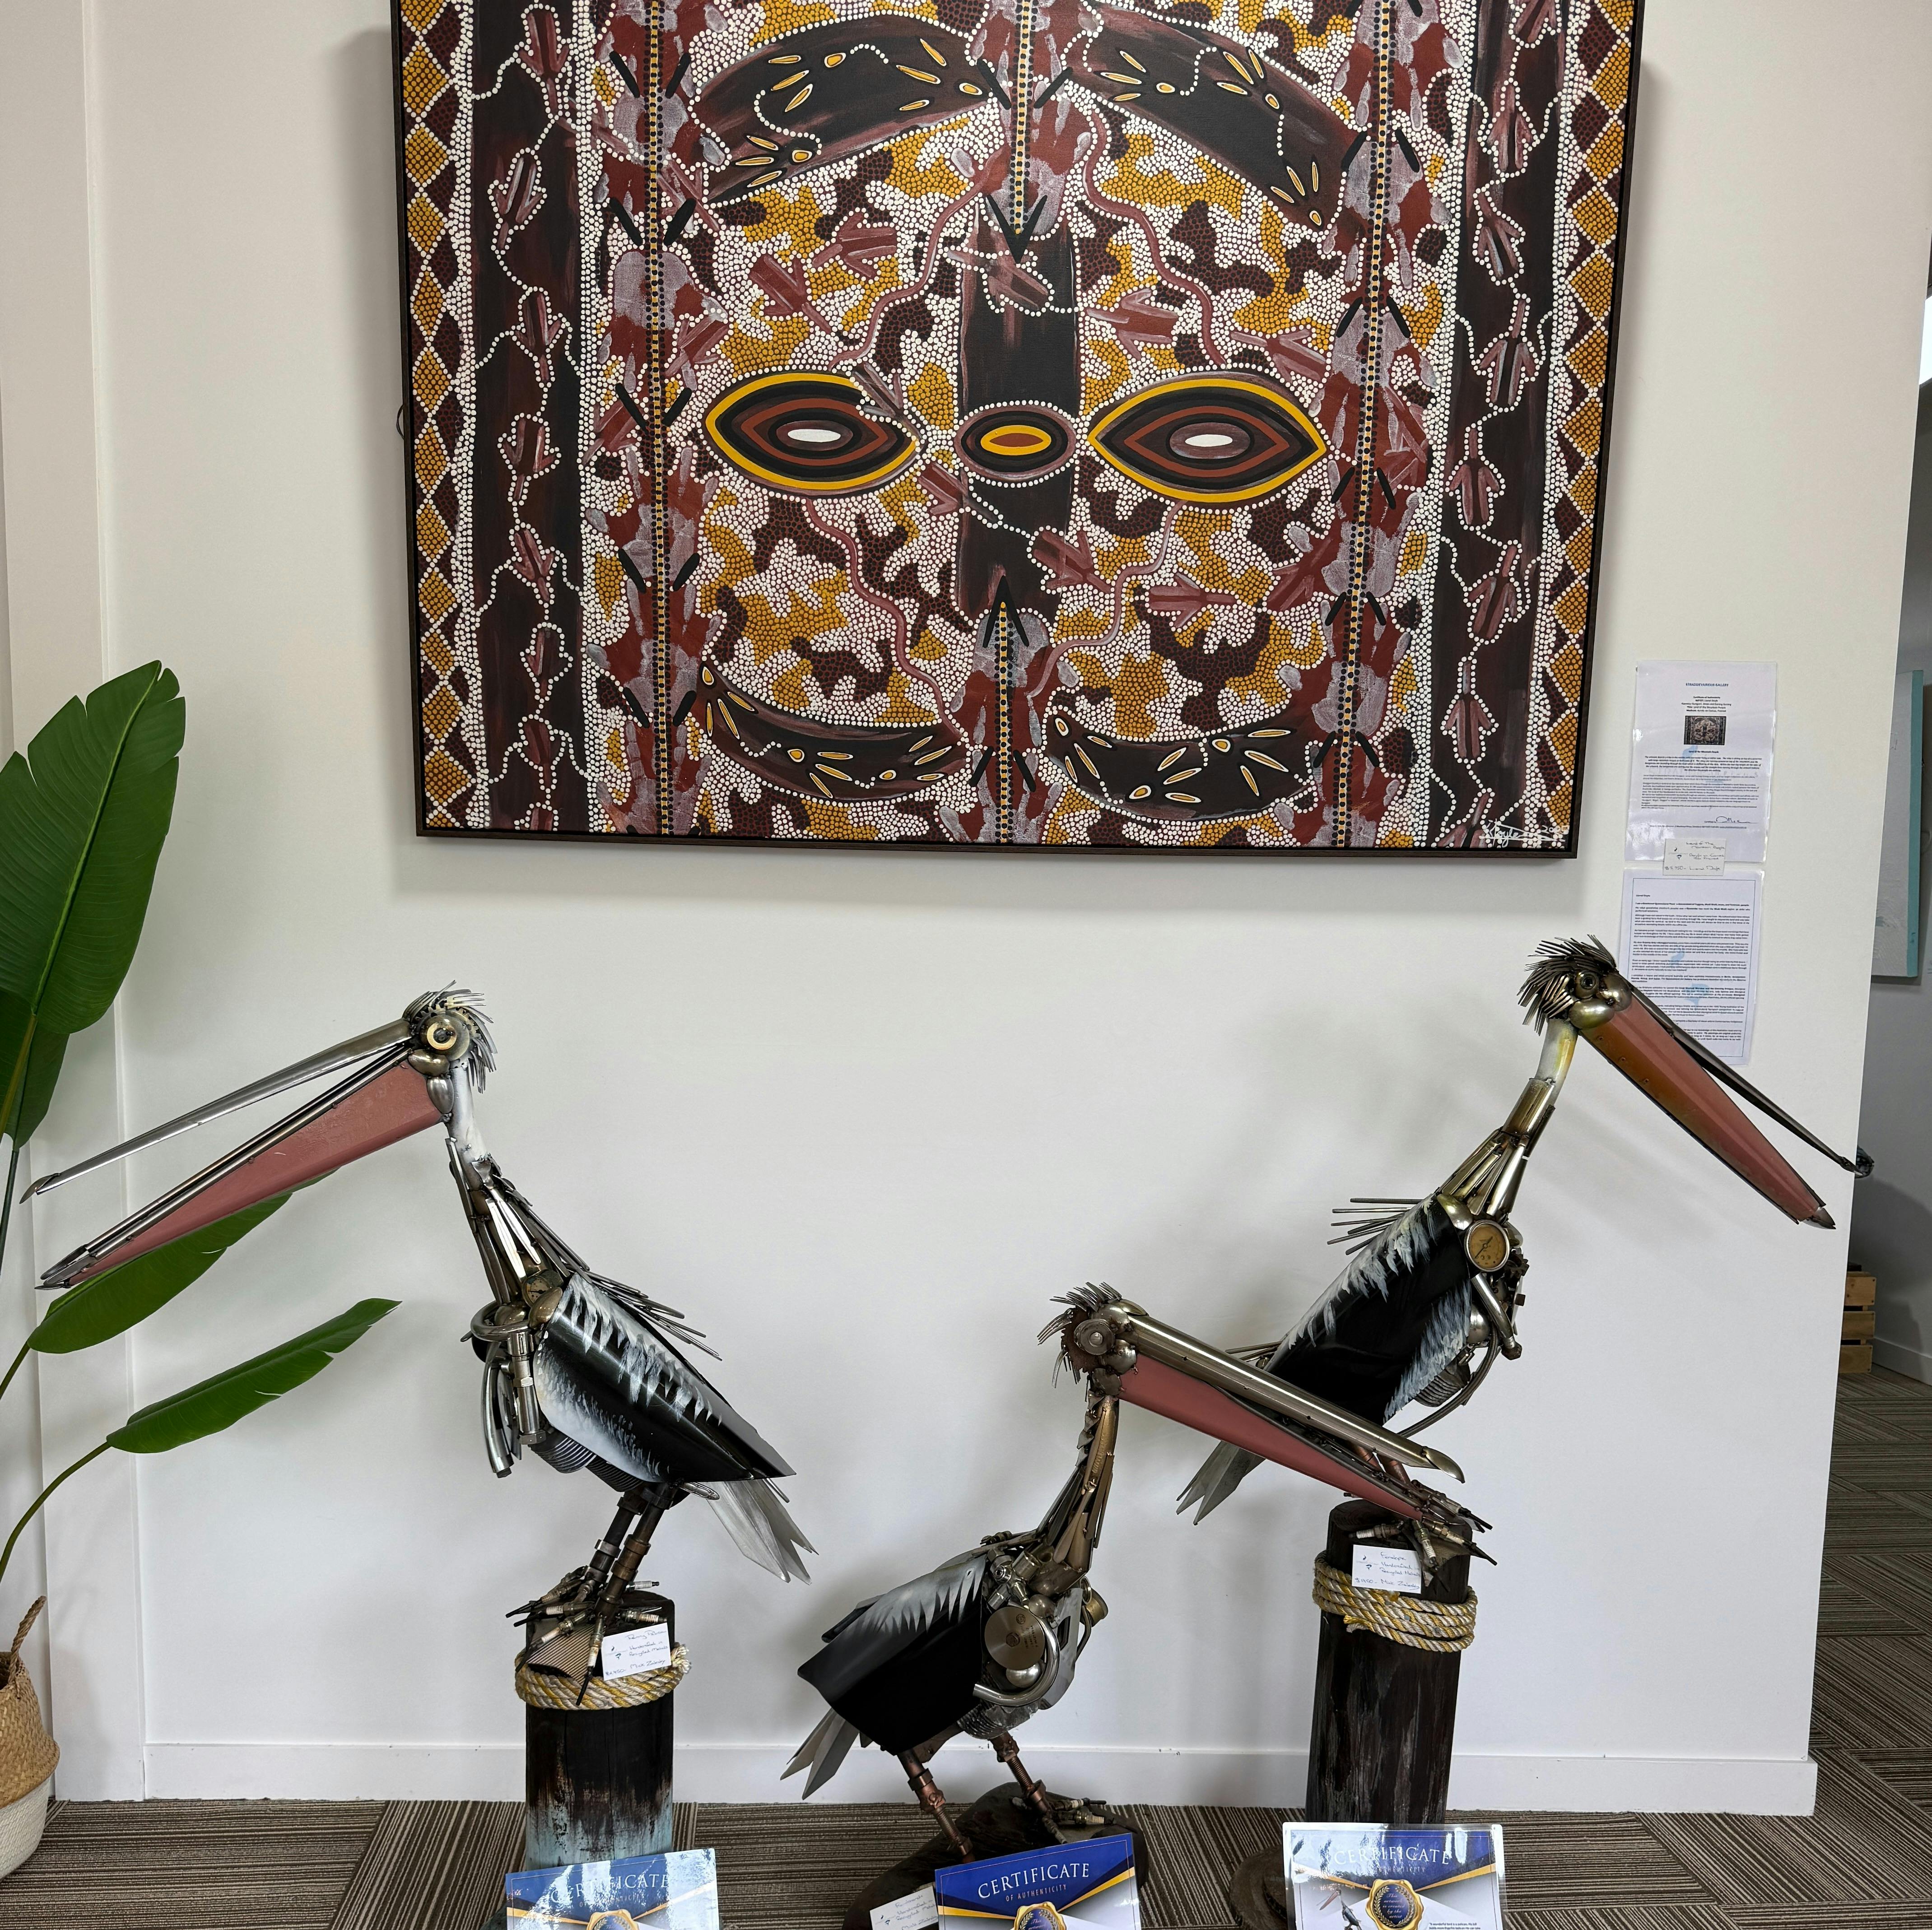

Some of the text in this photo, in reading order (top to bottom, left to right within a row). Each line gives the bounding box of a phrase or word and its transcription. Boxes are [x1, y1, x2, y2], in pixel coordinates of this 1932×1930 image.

[1334, 1846, 1450, 1865] CERTIFICATE
[978, 1863, 1089, 1898] CERTIFICATE
[1018, 1884, 1066, 1899] AUTHENTICITY
